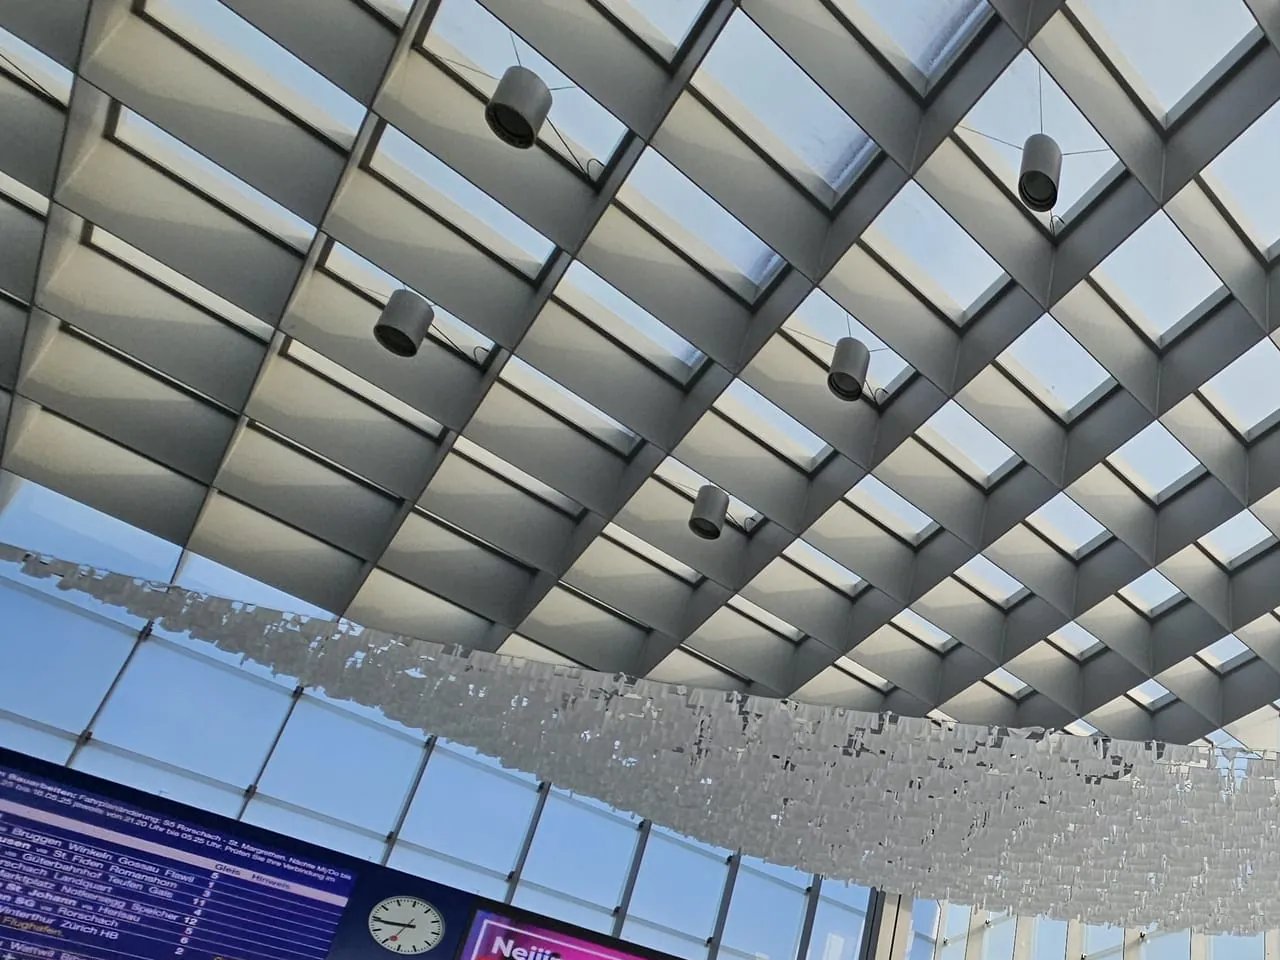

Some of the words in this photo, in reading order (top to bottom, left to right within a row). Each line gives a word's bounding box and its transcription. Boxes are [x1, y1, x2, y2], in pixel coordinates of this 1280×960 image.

[11, 826, 62, 847] Bruggen
[67, 841, 113, 860] Winkeln
[117, 856, 160, 873] Gossau
[163, 868, 195, 883] Flawil
[105, 811, 123, 820] von
[148, 822, 165, 833] Uhr
[166, 828, 180, 836] bis
[205, 840, 221, 849] Uhr.
[224, 845, 250, 858] Prüfen
[282, 862, 325, 880] Verbindung
[176, 823, 221, 841] Rorschach
[227, 839, 238, 847] St.
[241, 843, 285, 860] Margrethen.
[21, 851, 102, 879] Güterbahnhof
[107, 874, 143, 890] Teufen
[148, 885, 173, 898] Gais
[192, 897, 205, 906] 11
[52, 849, 67, 860] St.
[71, 854, 104, 869] Fiden
[108, 865, 178, 889] Romanshorn
[201, 890, 211, 898] 3
[53, 872, 113, 893] Landquart
[192, 908, 202, 916] 4
[210, 871, 220, 880] 5
[214, 862, 241, 875] Gleis
[251, 873, 290, 889] Hinweis
[5, 882, 22, 894] St.
[27, 887, 77, 906] Johann
[97, 906, 140, 922] Herisau
[183, 927, 193, 935] 5
[14, 896, 36, 907] SG
[56, 906, 119, 927] Rorschach
[179, 936, 189, 944] 6
[60, 884, 126, 909] Notkersegg
[131, 902, 178, 919] Speicher
[183, 916, 198, 925] 12
[9, 941, 55, 958] Wattwil
[59, 918, 98, 935] Zürich
[99, 928, 119, 939] HB
[173, 946, 184, 955] 2
